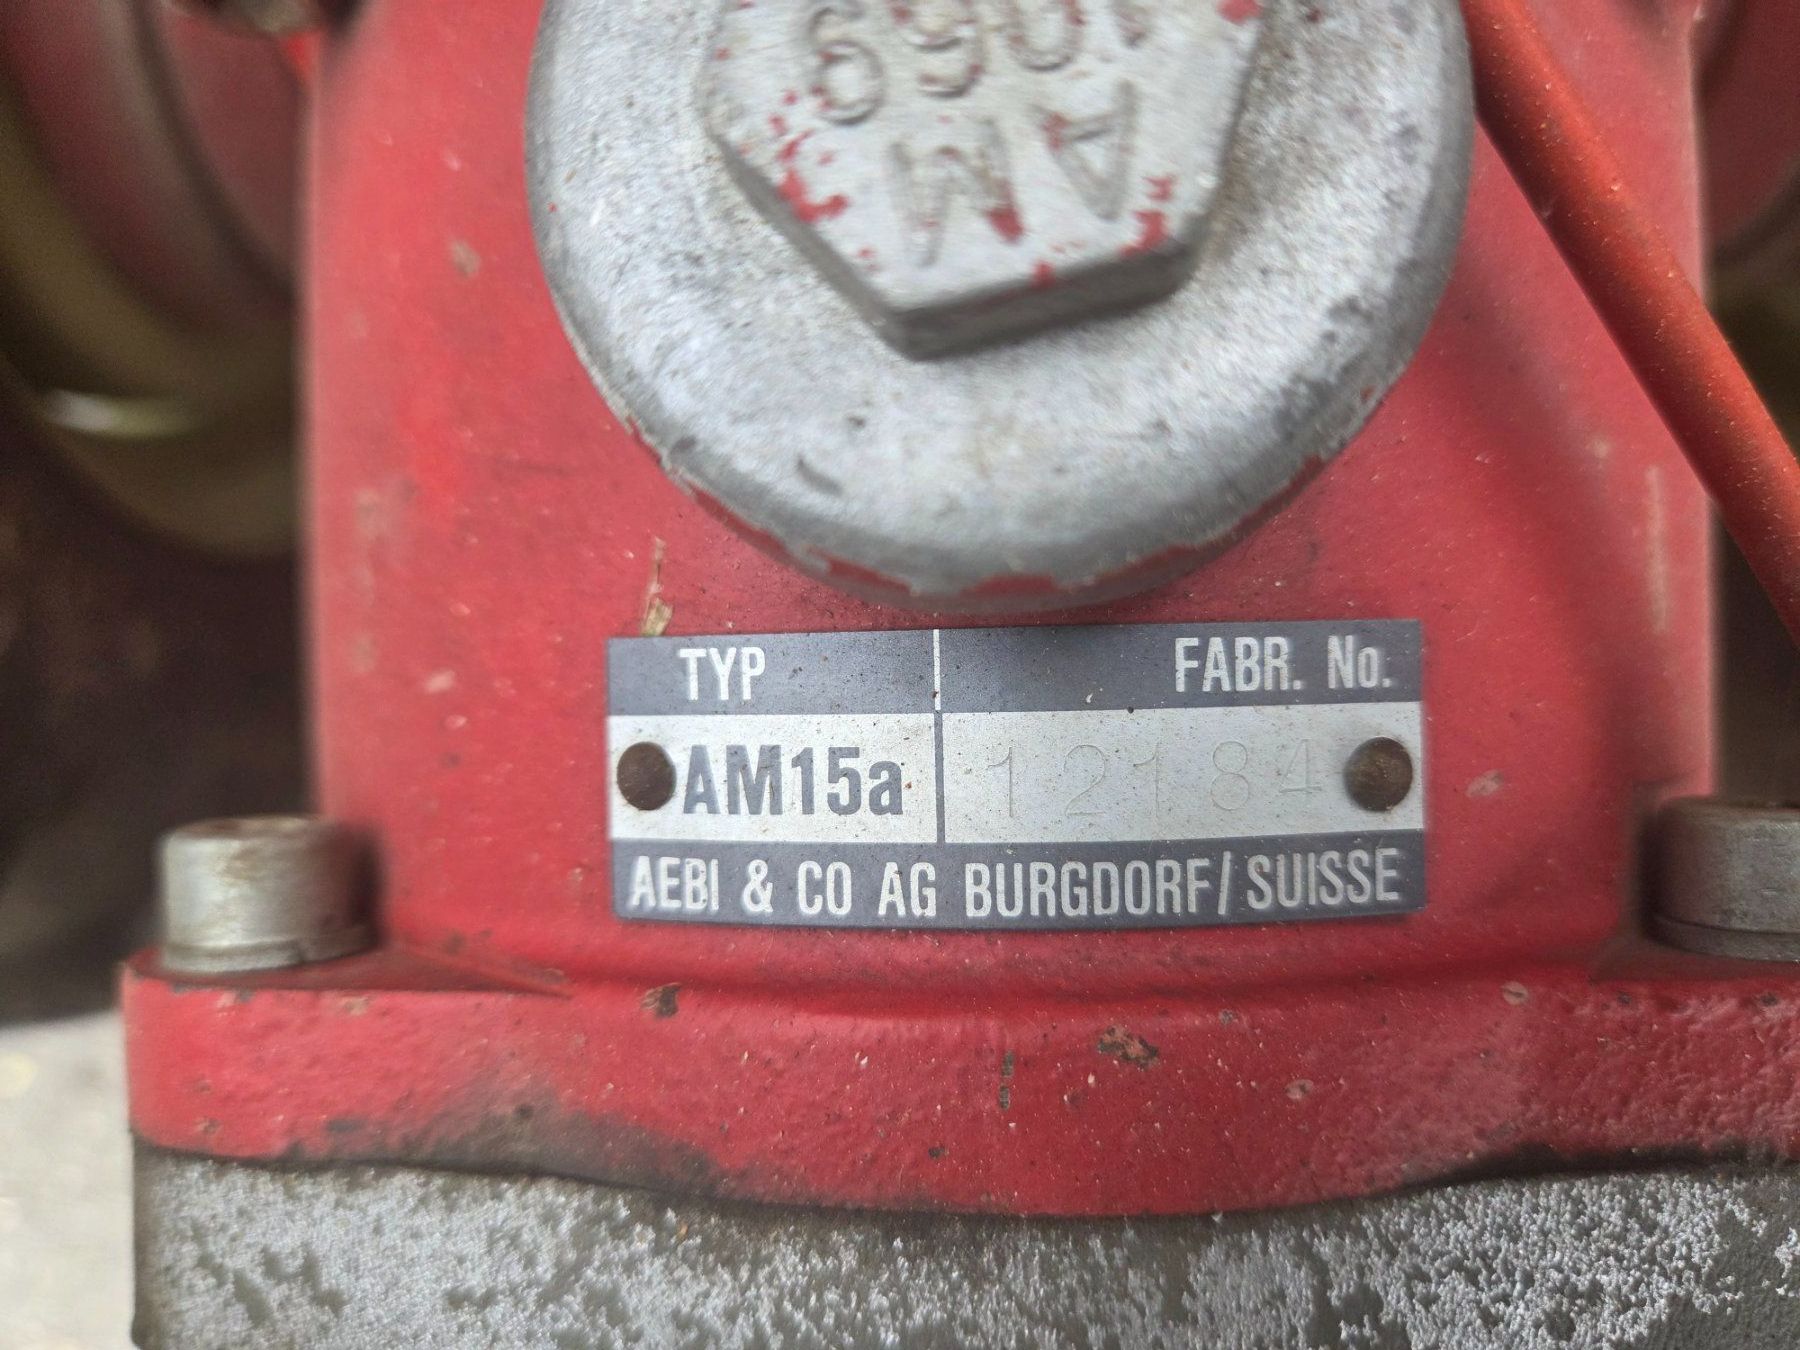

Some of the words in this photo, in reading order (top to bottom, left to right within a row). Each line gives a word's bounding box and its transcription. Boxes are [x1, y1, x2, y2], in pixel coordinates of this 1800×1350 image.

[888, 76, 1138, 268] AM
[678, 647, 766, 701] TYP
[1174, 636, 1304, 693] FABR.
[1327, 636, 1393, 691] No.
[682, 744, 905, 816] AM15a
[986, 738, 1323, 819] 12184
[629, 856, 720, 913] AEBI
[742, 858, 775, 914] &
[799, 860, 854, 916] CO
[877, 862, 939, 918] AG
